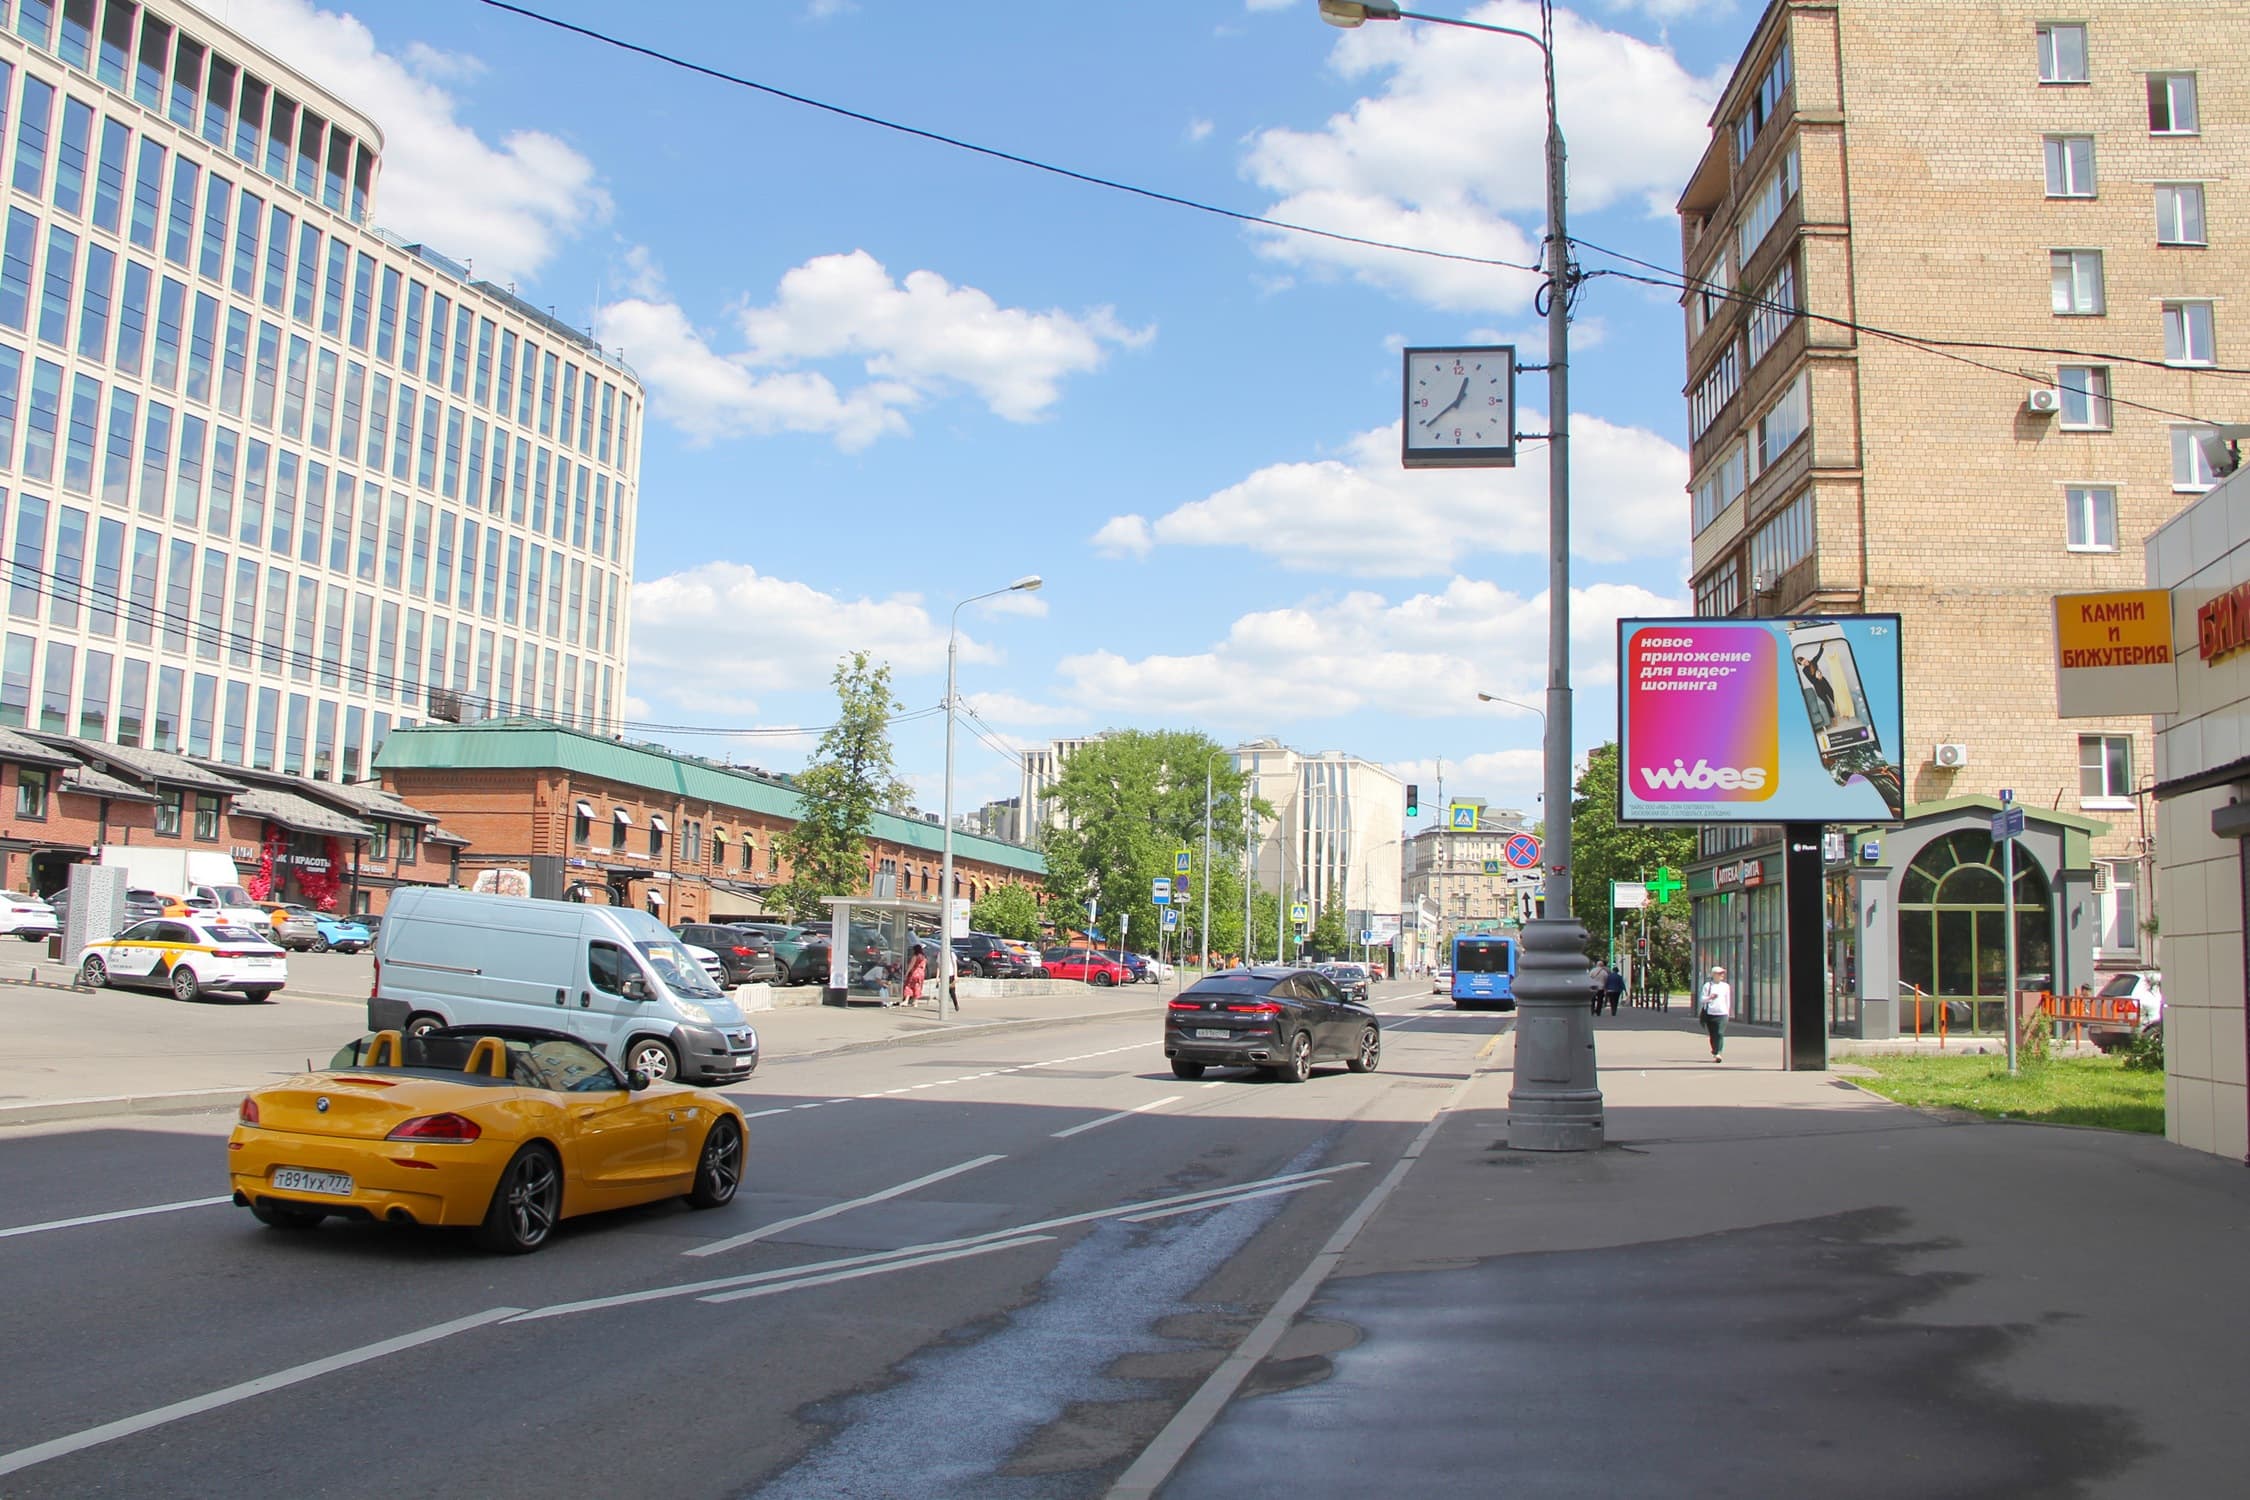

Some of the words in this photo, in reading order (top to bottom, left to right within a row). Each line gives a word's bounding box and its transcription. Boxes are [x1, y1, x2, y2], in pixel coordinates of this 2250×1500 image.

[1453, 367, 1464, 375] 12
[1421, 399, 1429, 407] 9
[1488, 397, 1495, 406] 3
[1454, 428, 1462, 437] 6
[2081, 601, 2145, 623] КАМНИ
[1869, 625, 1889, 636] 12+
[1640, 636, 1693, 648] новое
[1640, 651, 1752, 663] приложение
[2063, 645, 2169, 668] БИЖУТЕРИЯ
[1640, 666, 1673, 679] для
[1676, 665, 1737, 678] видео-
[1640, 680, 1718, 692] шопинга
[1640, 758, 1767, 790] wibes
[1718, 864, 1739, 885] АПТЕКА
[1166, 911, 1176, 922] P
